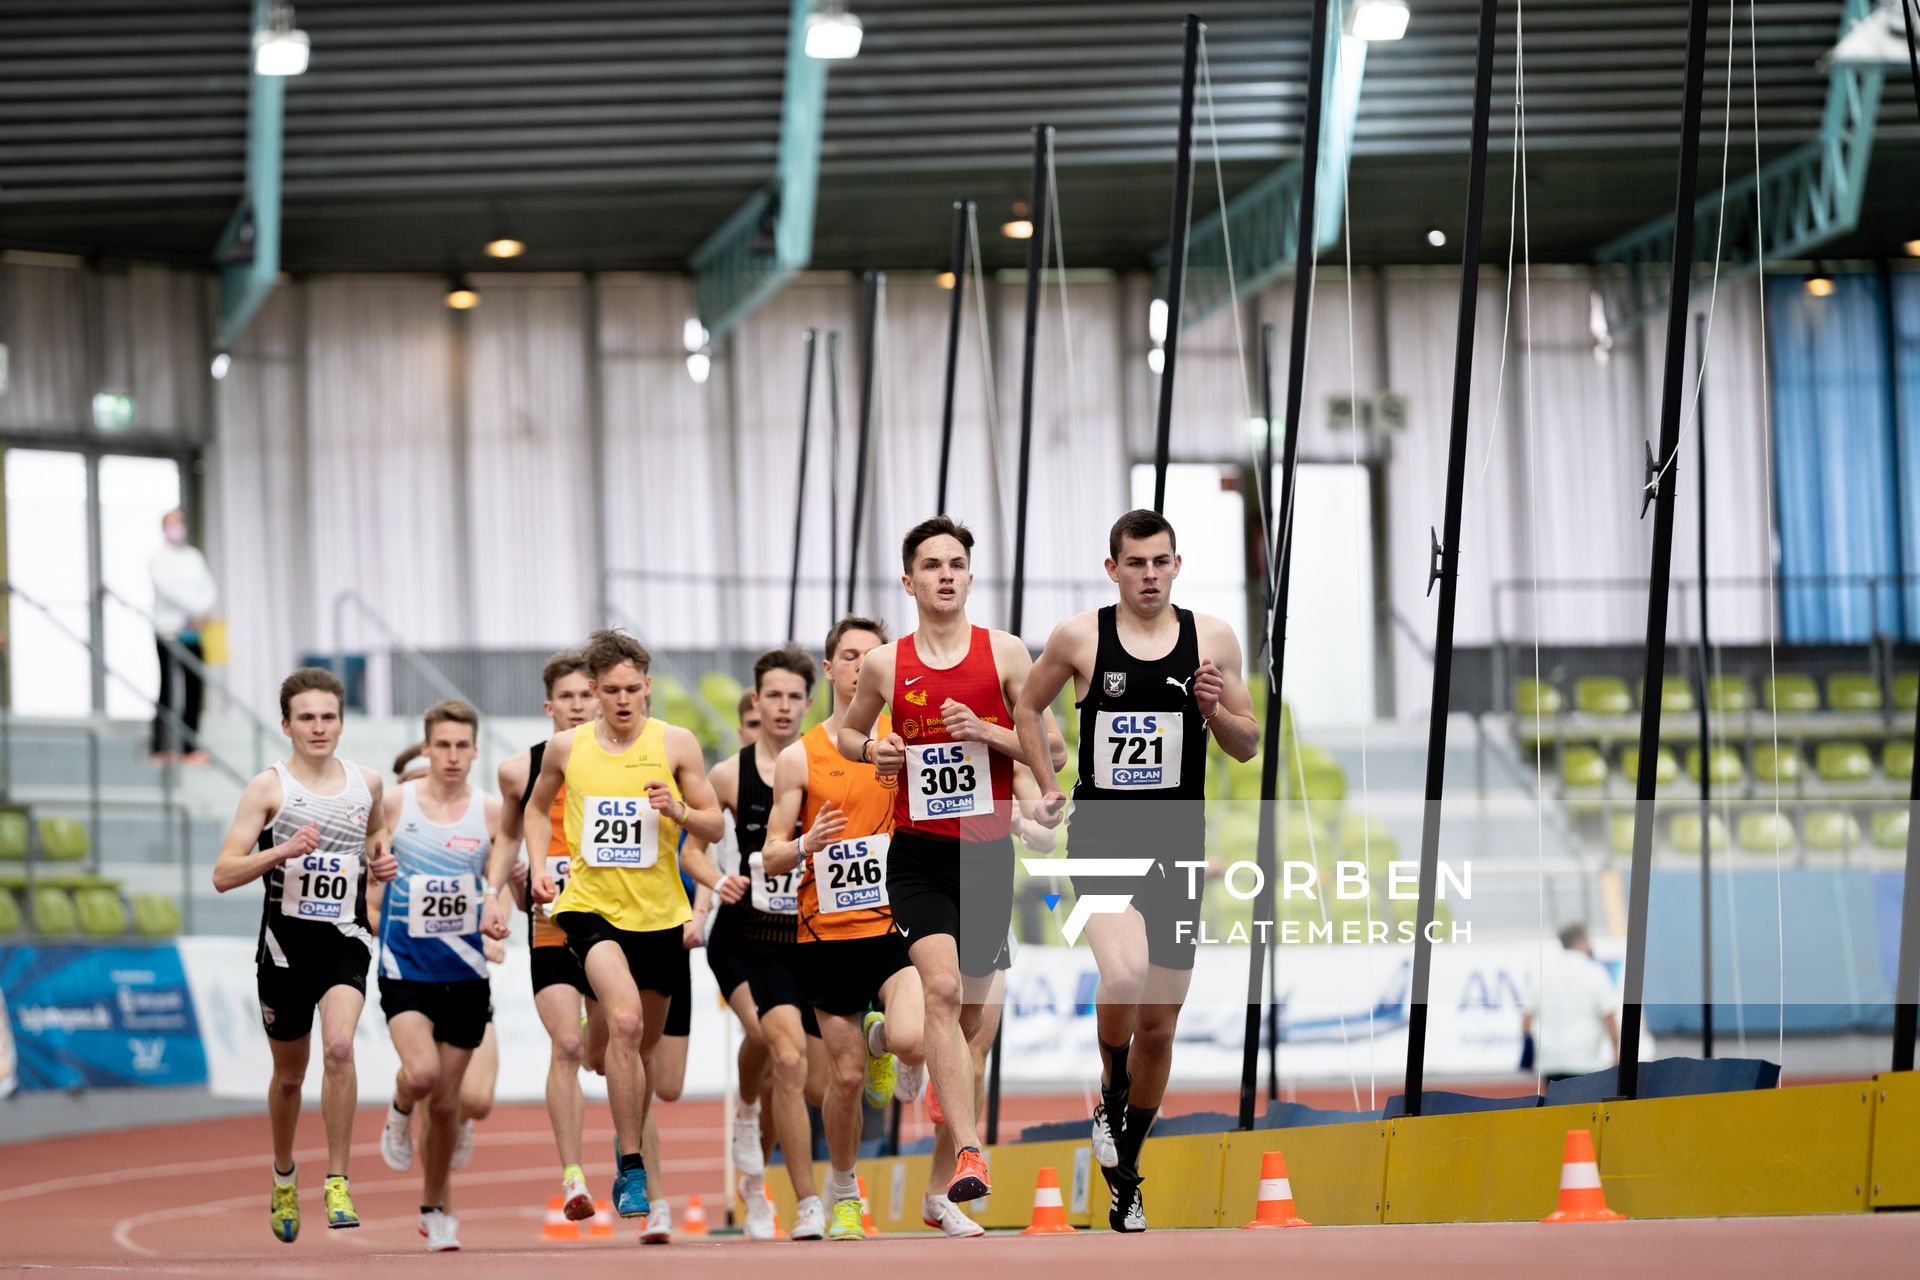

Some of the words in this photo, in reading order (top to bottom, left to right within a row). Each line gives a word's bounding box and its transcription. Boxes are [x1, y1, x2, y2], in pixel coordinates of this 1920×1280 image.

[1108, 736, 1163, 765] 721
[920, 764, 976, 796] 303
[1133, 771, 1160, 779] PLAN
[946, 797, 973, 808] PLAN
[594, 819, 642, 844] 291
[614, 850, 640, 858] PLAN
[764, 871, 800, 893] 57
[828, 858, 882, 889] 246
[298, 873, 347, 900] 160
[853, 889, 879, 901] PLAN
[315, 903, 340, 914] PLAN
[422, 895, 467, 917] 266
